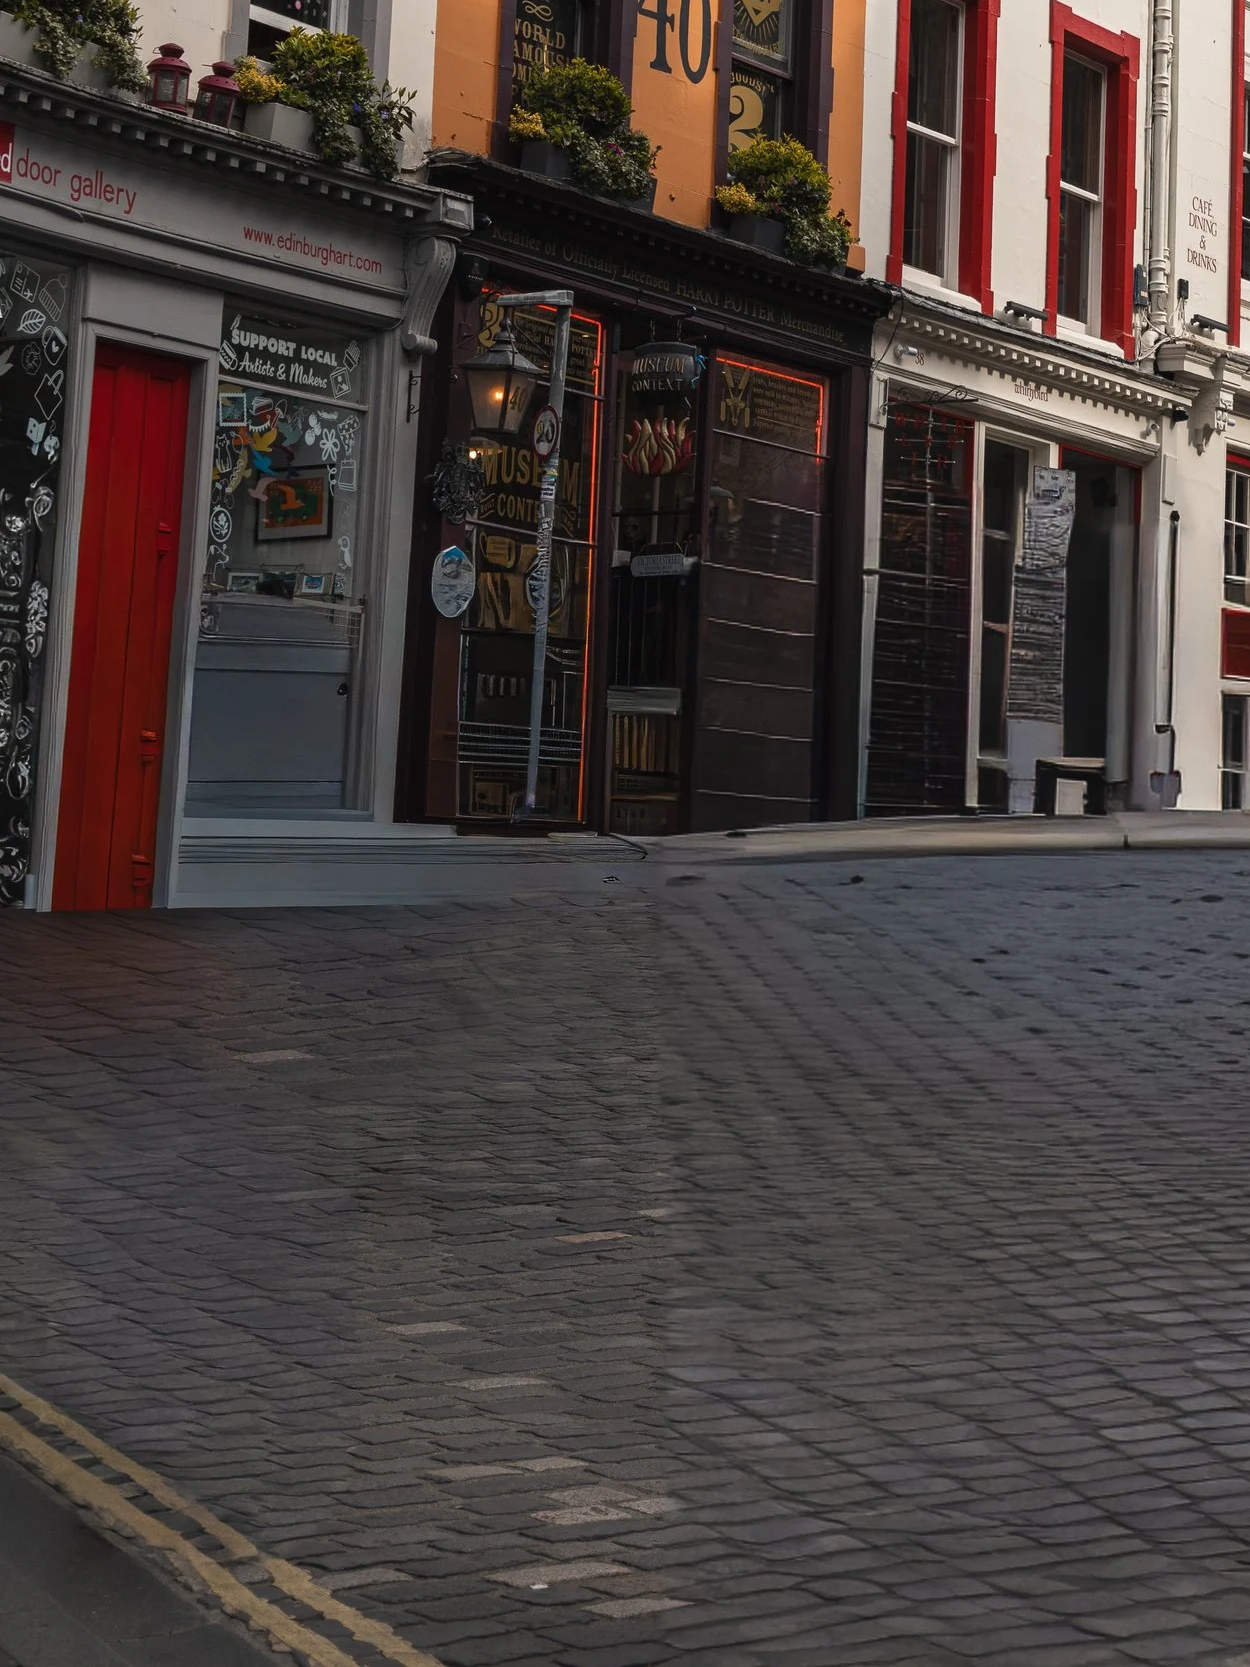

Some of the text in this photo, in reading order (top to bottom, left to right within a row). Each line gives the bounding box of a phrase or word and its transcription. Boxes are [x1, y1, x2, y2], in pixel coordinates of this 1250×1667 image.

[16, 148, 62, 187] door
[70, 169, 137, 214] gallery
[1188, 212, 1218, 237] DINING
[1199, 235, 1207, 251] &
[1187, 248, 1218, 274] DRINKS
[492, 227, 541, 253] Retailer
[544, 241, 558, 256] of
[676, 277, 720, 307] HARRY
[724, 293, 775, 323] POTTER
[780, 308, 845, 344] Merchandise
[231, 328, 338, 368] SUPPORT LOCAL
[238, 351, 328, 389] Artists & Makers
[632, 356, 686, 376] MUSEUM
[632, 378, 684, 392] CONTEXT
[536, 420, 556, 445] 20
[481, 444, 581, 508] MUSEM
